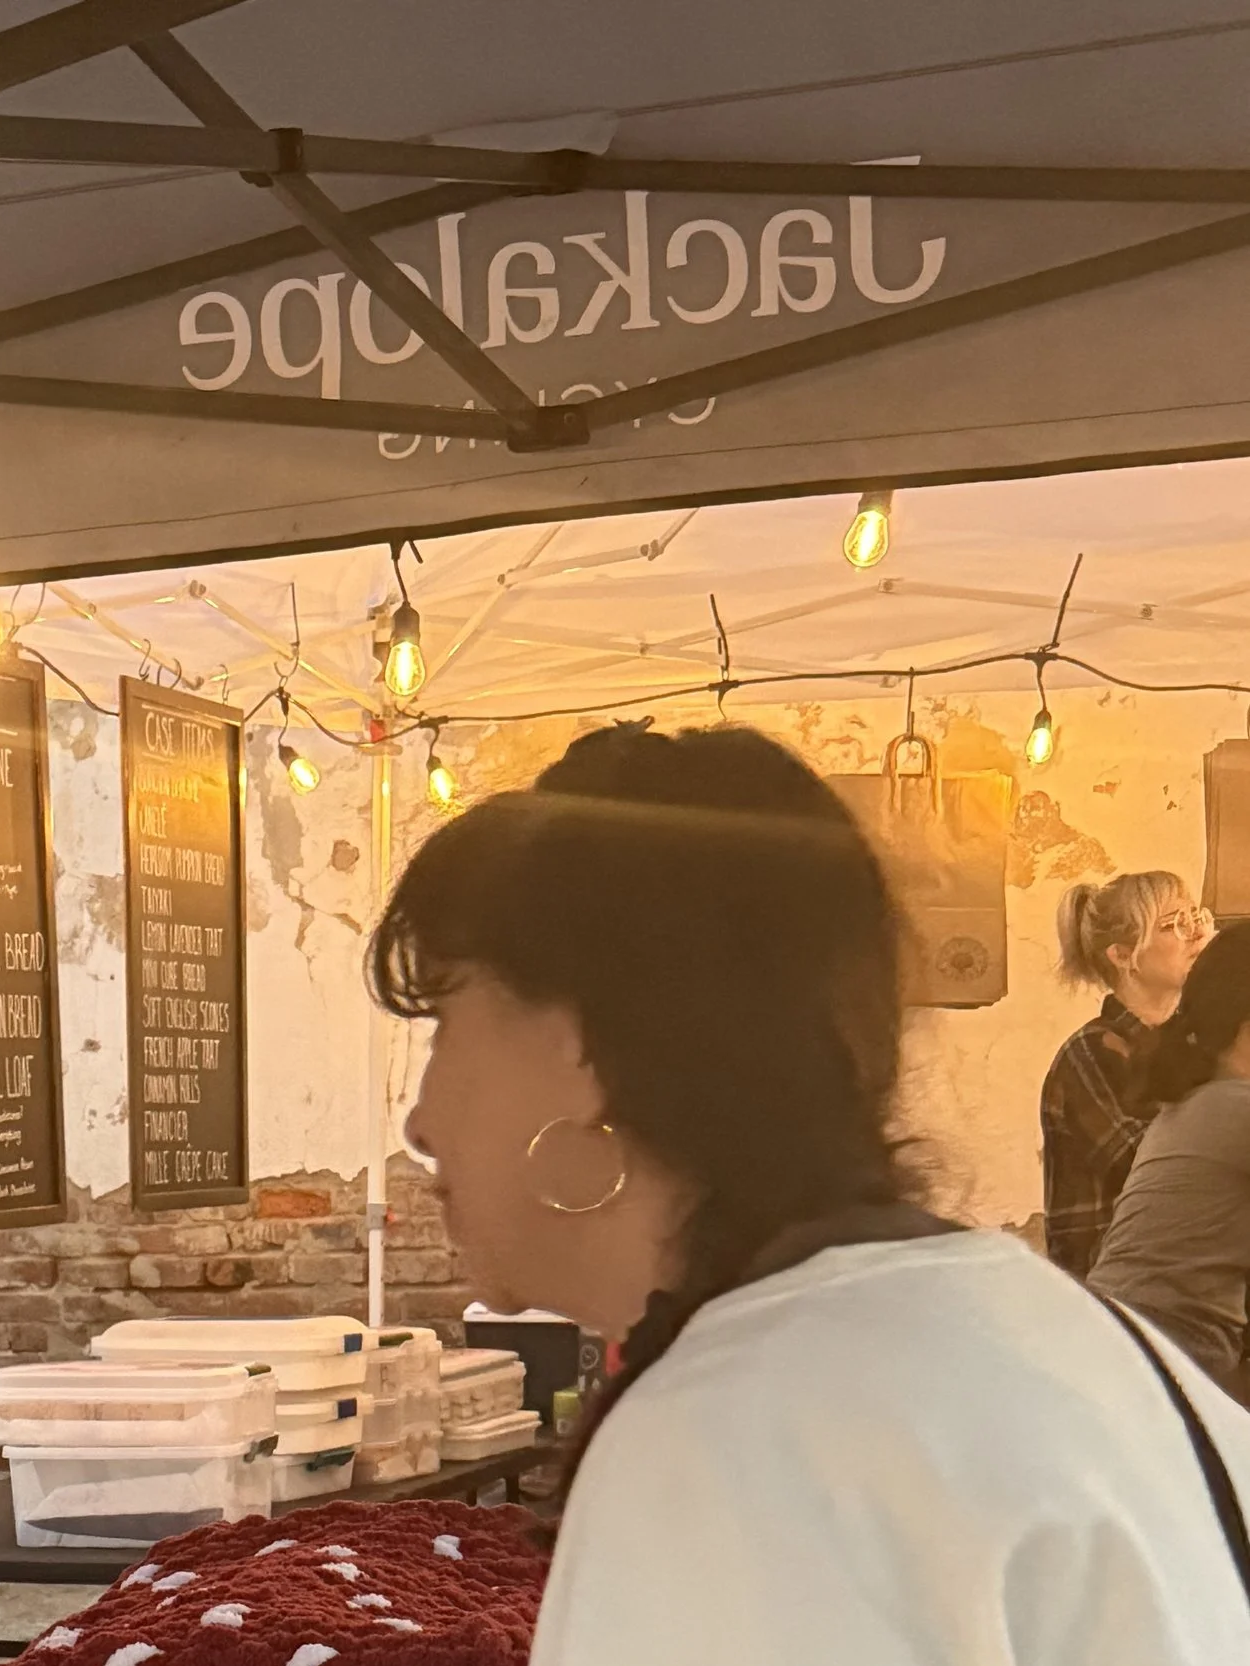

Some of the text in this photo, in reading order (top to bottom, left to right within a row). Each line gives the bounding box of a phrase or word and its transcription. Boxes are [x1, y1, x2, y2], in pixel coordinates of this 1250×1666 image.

[145, 712, 215, 764] CASE ITEMS
[5, 931, 45, 972] BREAD
[8, 994, 42, 1038] BREAD
[6, 1055, 34, 1098] LOAF
[144, 1110, 189, 1142] FINANCIER
